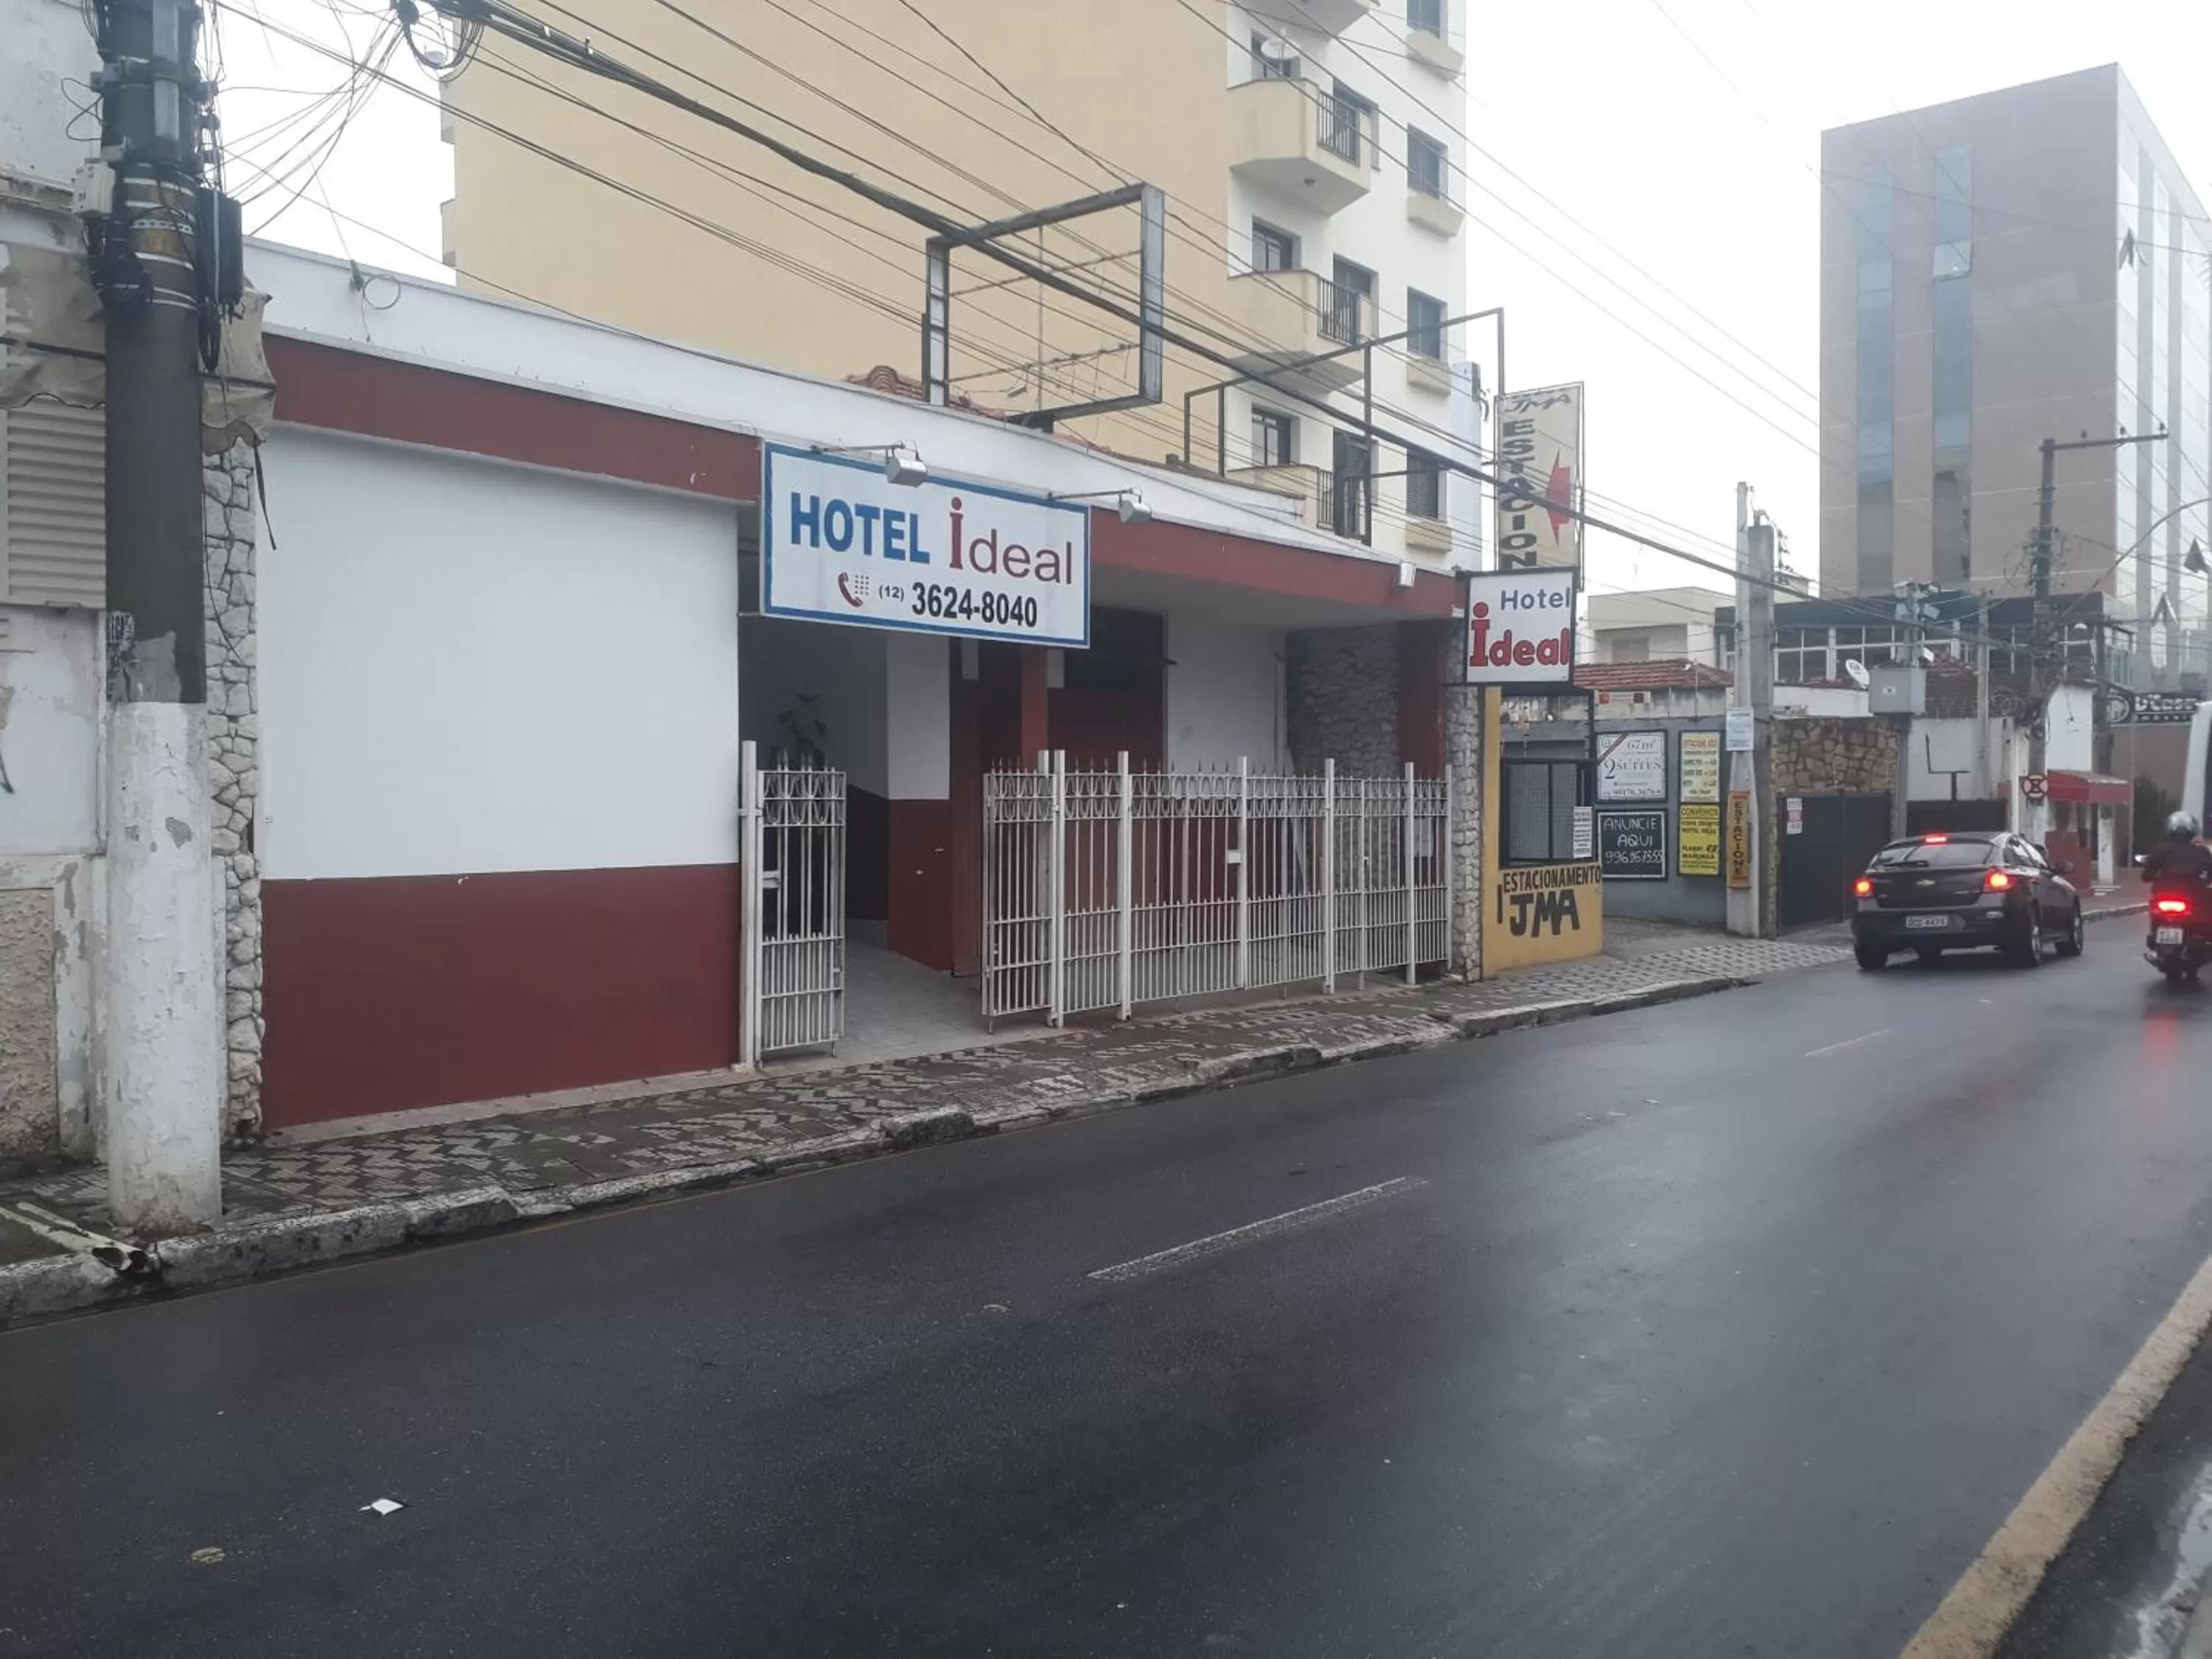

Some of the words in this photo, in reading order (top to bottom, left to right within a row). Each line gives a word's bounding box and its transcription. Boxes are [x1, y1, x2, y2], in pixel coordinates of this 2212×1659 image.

[790, 491, 931, 565] HOTEL
[878, 584, 905, 602] (12)
[911, 581, 1038, 628] 3624-8040
[1500, 587, 1571, 611] Hotel
[1604, 758, 1615, 779] 2
[1603, 817, 1658, 831] ANUNCIE
[1616, 834, 1653, 847] AQUI
[1503, 865, 1601, 894] ESTACIONAMENTO
[1509, 888, 1581, 938] JMA
